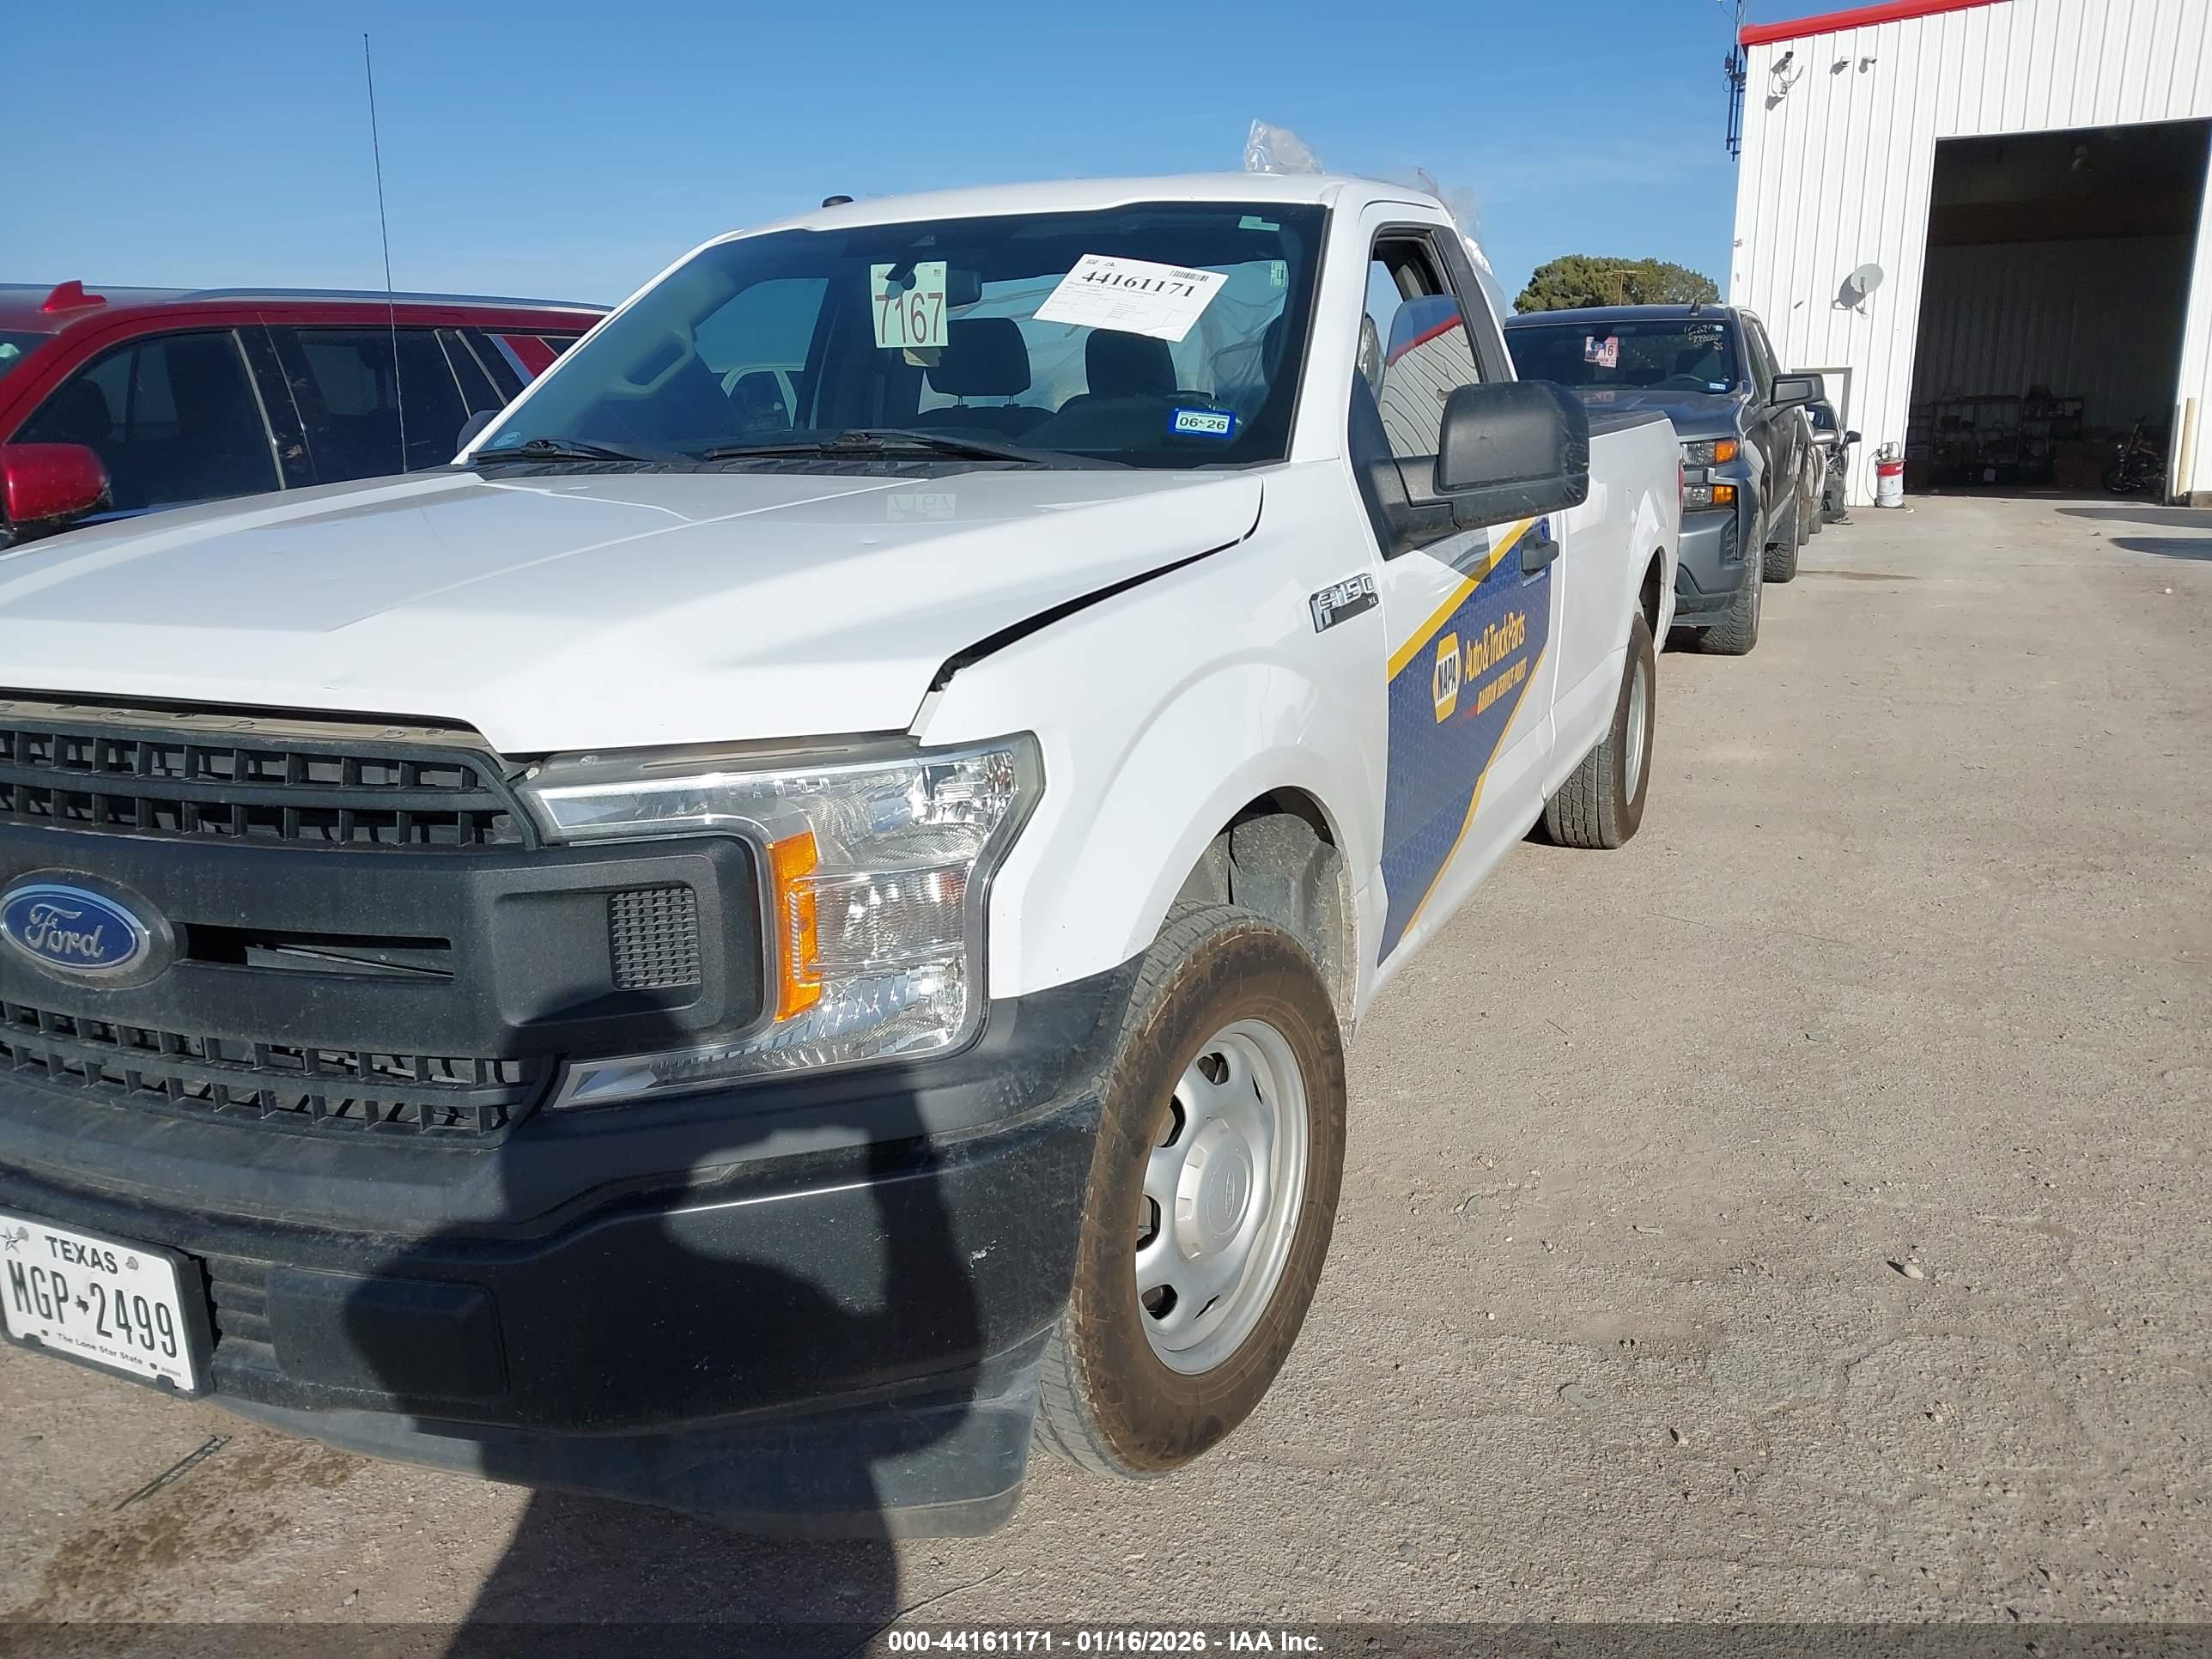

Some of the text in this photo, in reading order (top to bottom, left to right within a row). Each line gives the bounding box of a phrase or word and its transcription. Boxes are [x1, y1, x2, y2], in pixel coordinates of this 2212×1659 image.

[1081, 270, 1196, 298] 44161171
[874, 292, 944, 344] 7167
[1179, 416, 1226, 430] 06 26
[1367, 595, 1378, 607] XL
[1464, 639, 1483, 685] Auto
[1509, 609, 1526, 654] Parts
[1437, 653, 1457, 702] NAPA
[24, 903, 104, 958] Ford
[45, 1235, 118, 1274] TEXAS
[89, 1282, 177, 1358] 2499
[57, 1332, 143, 1364] The Lone Star State
